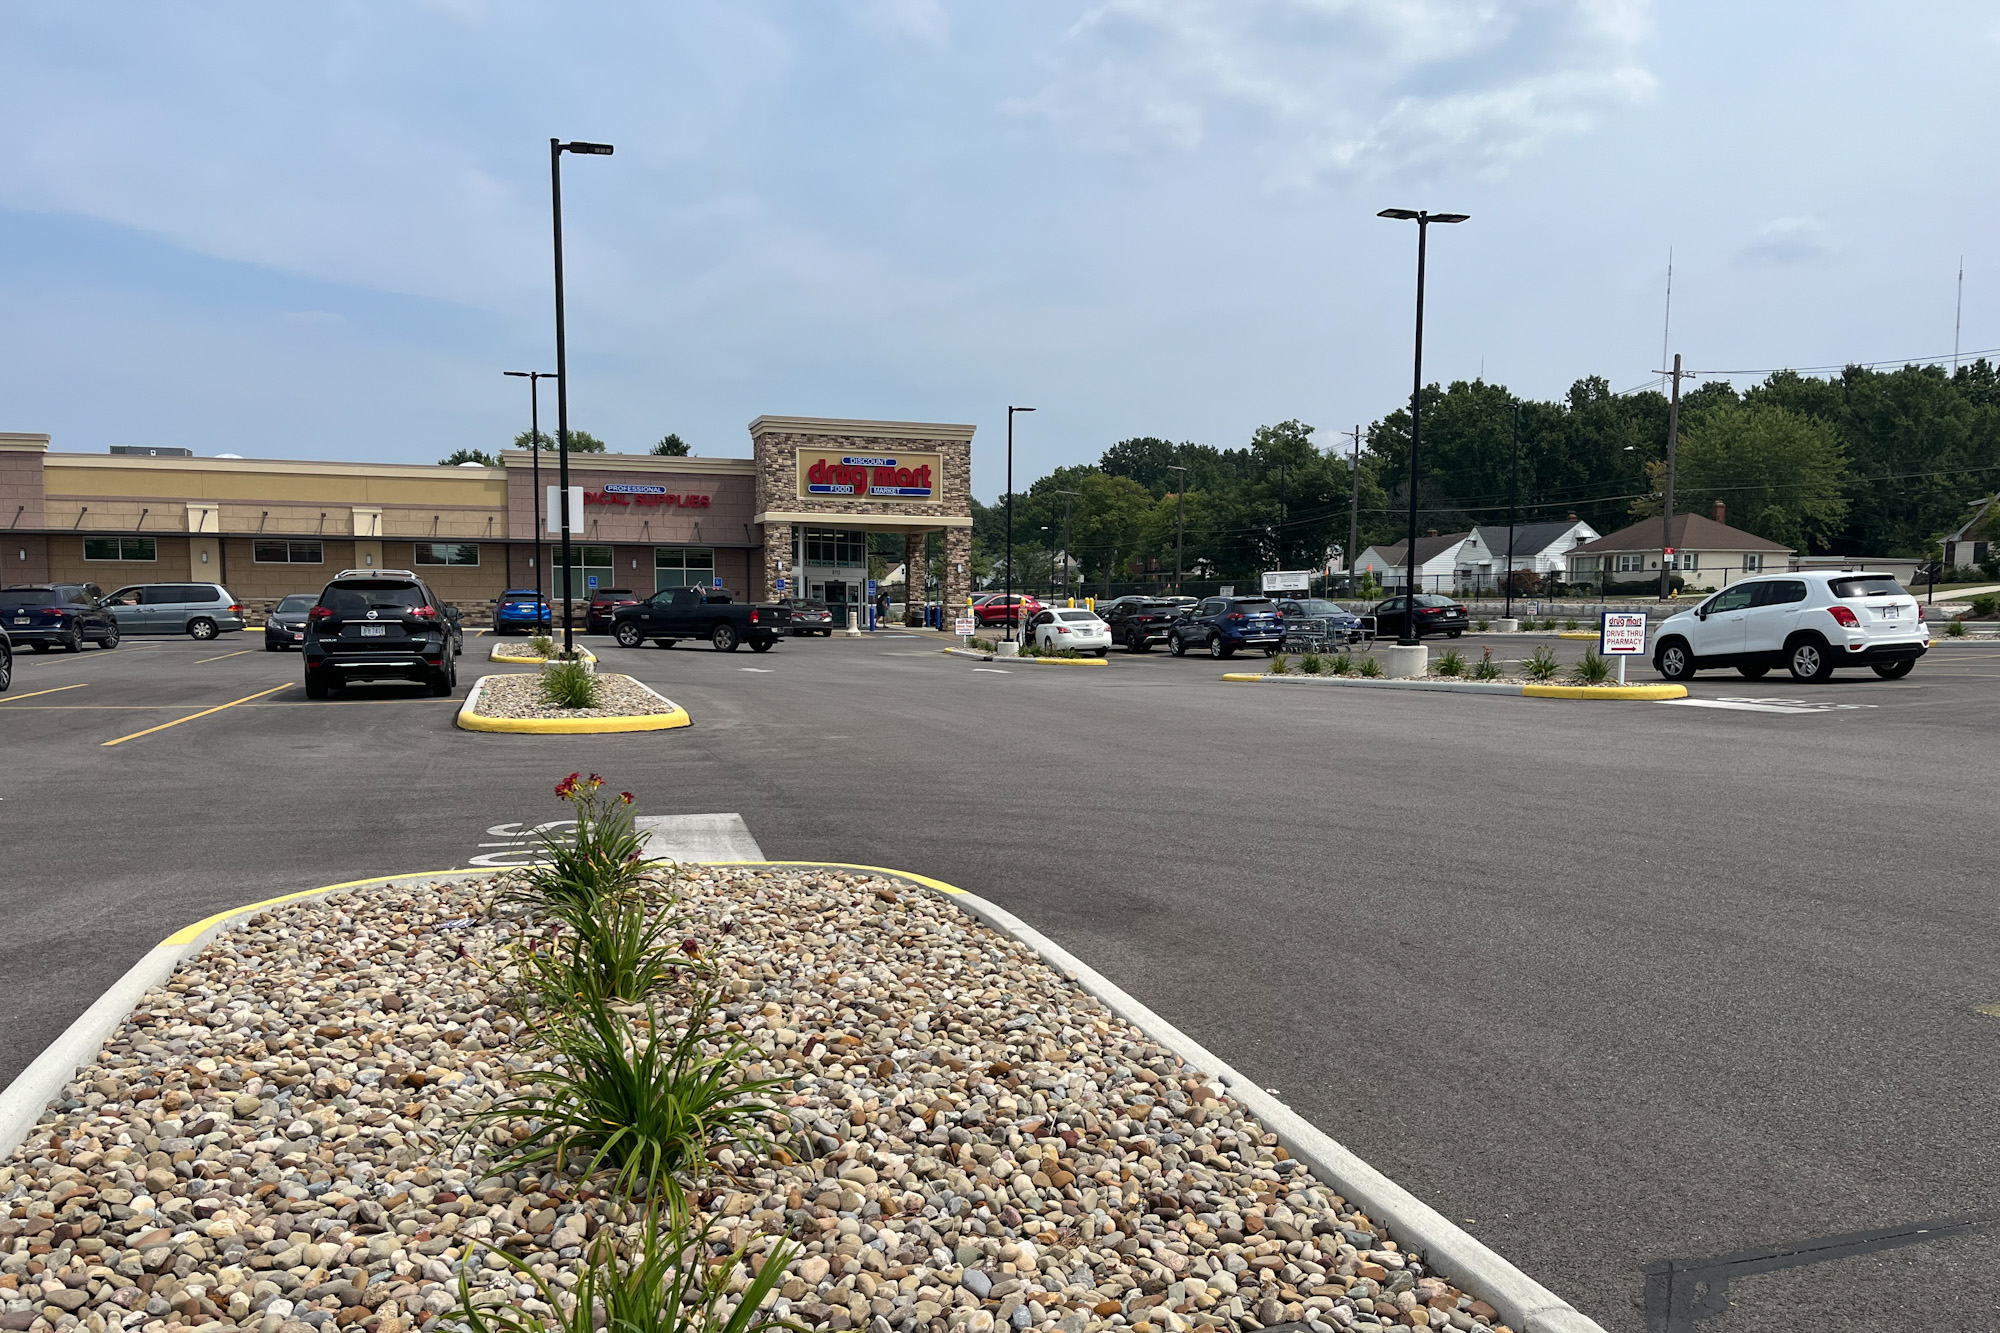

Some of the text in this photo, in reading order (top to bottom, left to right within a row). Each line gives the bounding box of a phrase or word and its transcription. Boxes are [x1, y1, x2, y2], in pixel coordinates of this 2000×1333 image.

[850, 457, 888, 466] DISCOUNT
[808, 459, 932, 494] drug mart
[607, 485, 663, 493] PROFESSIONAL
[873, 487, 901, 495] MARKET
[583, 491, 711, 509] DICAL SUPPLIES
[1609, 617, 1641, 627] drug mart
